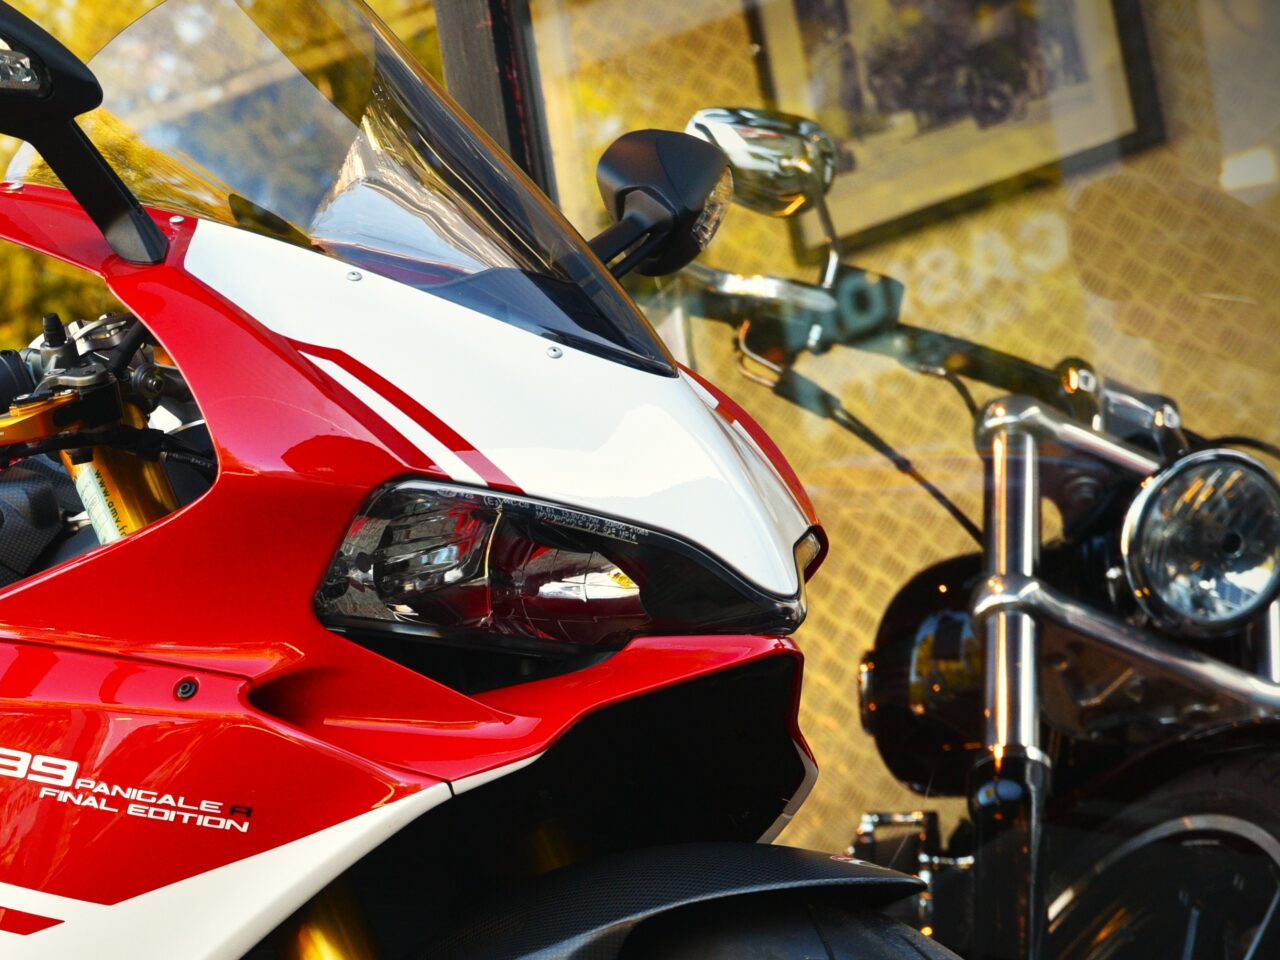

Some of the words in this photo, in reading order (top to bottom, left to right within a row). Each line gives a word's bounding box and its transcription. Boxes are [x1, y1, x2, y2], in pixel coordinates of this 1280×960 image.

[39, 787, 119, 813] FINAL
[126, 804, 250, 833] EDITION
[75, 778, 224, 814] PANIGALE
